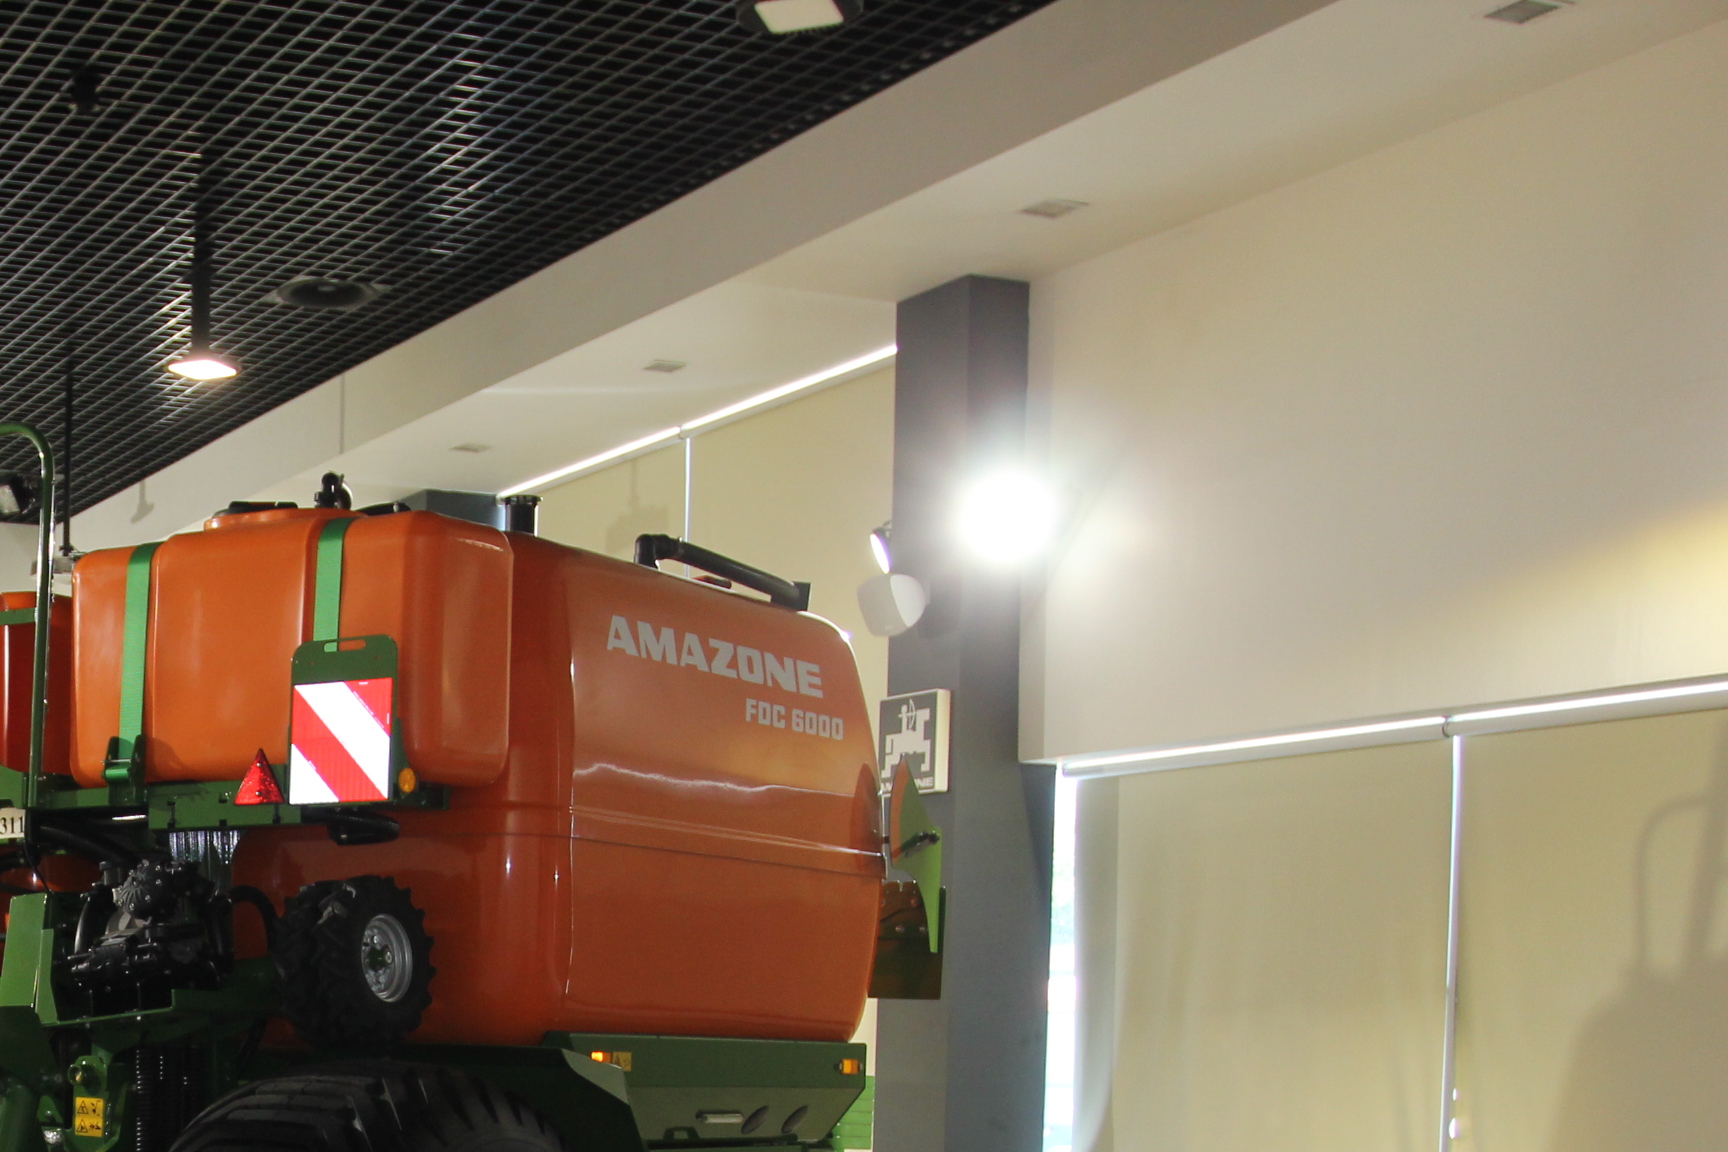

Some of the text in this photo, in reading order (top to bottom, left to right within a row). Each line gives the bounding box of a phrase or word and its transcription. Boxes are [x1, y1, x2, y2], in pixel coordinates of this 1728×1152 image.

[607, 615, 823, 698] AMAZONE
[745, 698, 844, 741] FDC 6000
[0, 816, 24, 835] 311
